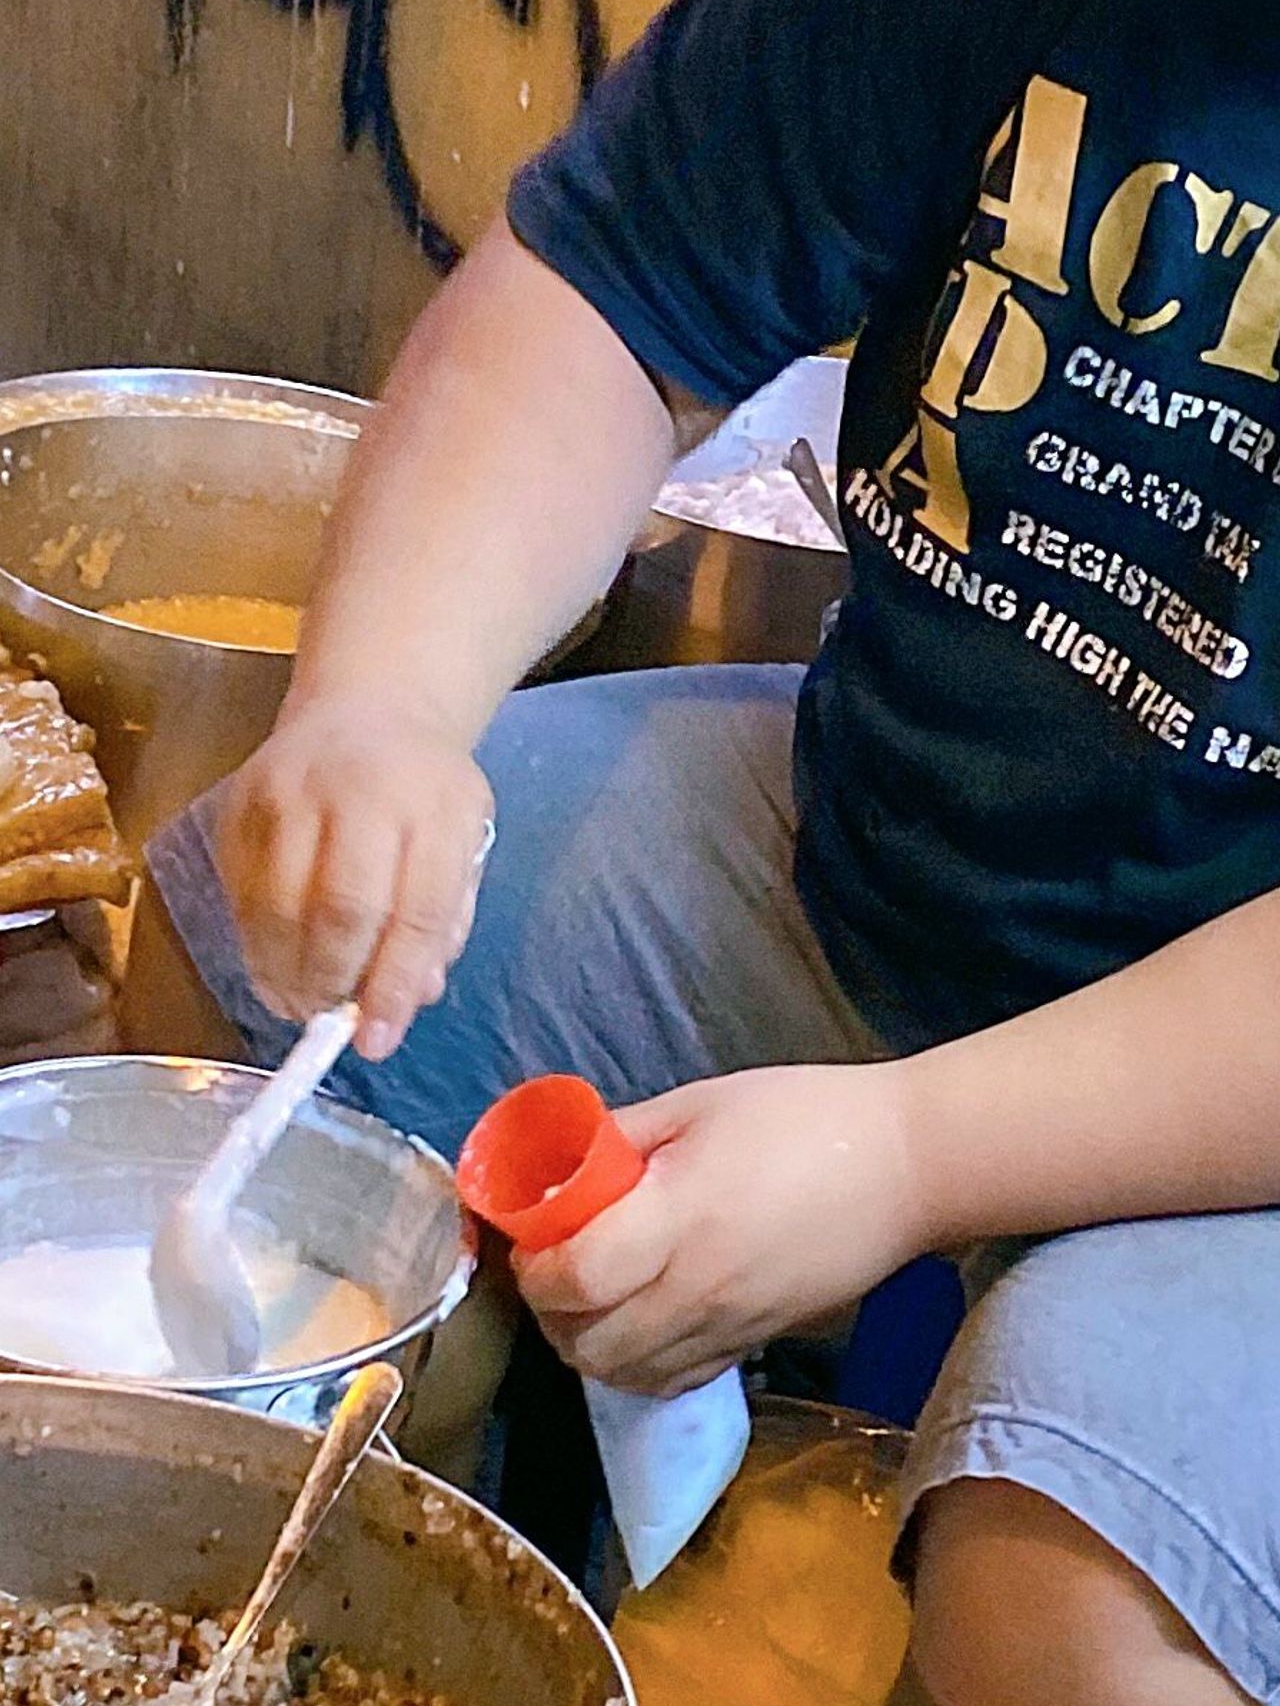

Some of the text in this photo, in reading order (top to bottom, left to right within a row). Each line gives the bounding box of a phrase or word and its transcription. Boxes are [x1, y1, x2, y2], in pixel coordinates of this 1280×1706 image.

[844, 467, 1018, 621] HOLDING
[1025, 601, 1134, 698] HIGH
[1125, 669, 1196, 751] THE
[1001, 510, 1251, 681] REGISTERED
